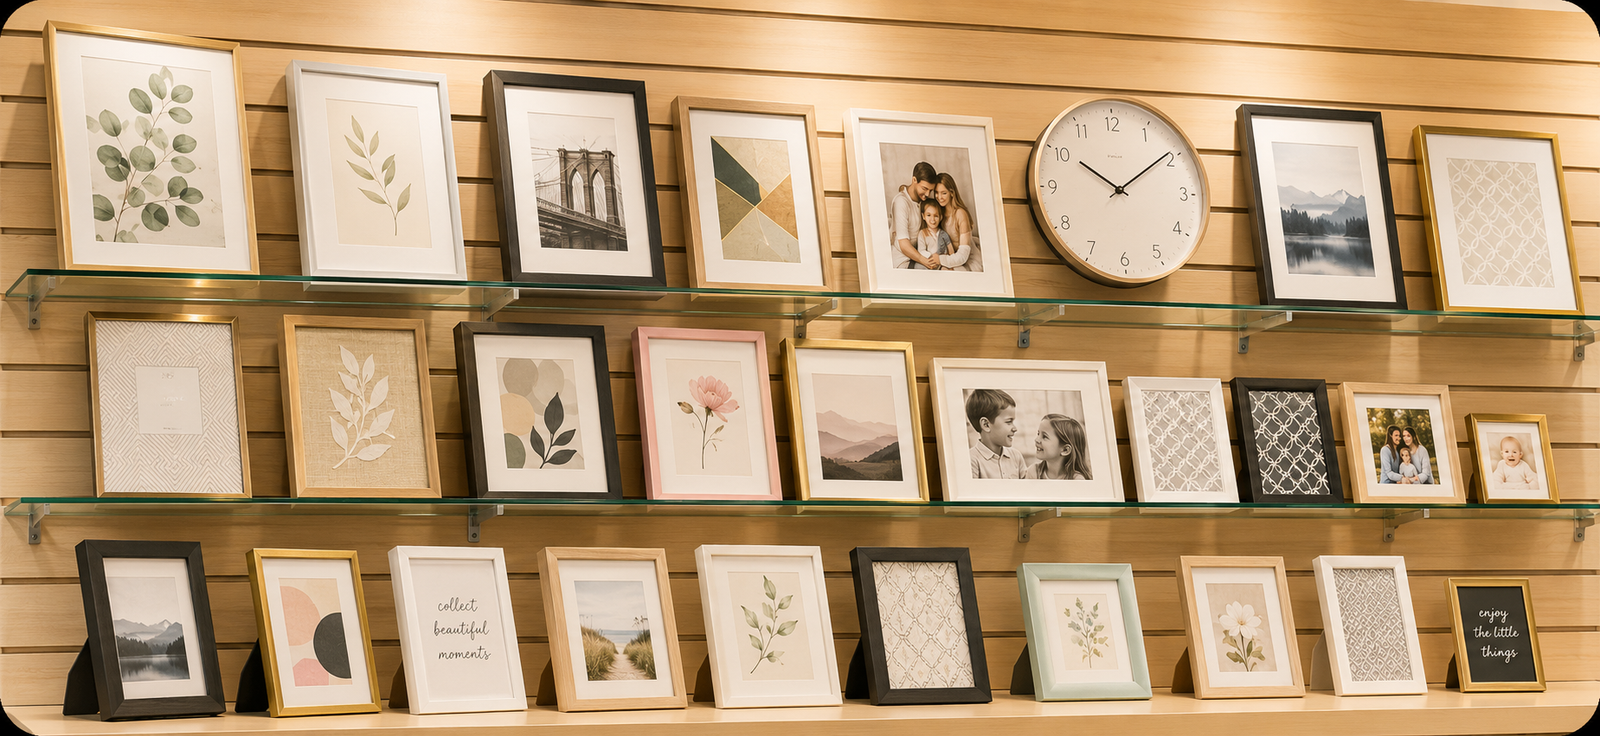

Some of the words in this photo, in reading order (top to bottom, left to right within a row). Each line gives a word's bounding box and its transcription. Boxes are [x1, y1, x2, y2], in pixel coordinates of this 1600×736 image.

[1075, 123, 1088, 139] 11
[1104, 116, 1120, 132] 12
[1142, 127, 1148, 142] 1
[1054, 146, 1070, 162] 10
[1166, 151, 1176, 167] 2
[1047, 179, 1058, 195] 9
[1179, 186, 1189, 202] 3
[1060, 214, 1071, 230] 8
[1172, 220, 1183, 235] 4
[1086, 240, 1096, 255] 7
[1152, 244, 1162, 259] 5
[1120, 251, 1130, 267] 6
[437, 596, 479, 612] collect
[1478, 607, 1509, 623] enjoy
[433, 619, 490, 641] beautiful
[1472, 625, 1492, 638] the
[1493, 625, 1520, 638] little
[438, 645, 492, 661] moments
[1480, 644, 1519, 664] things
